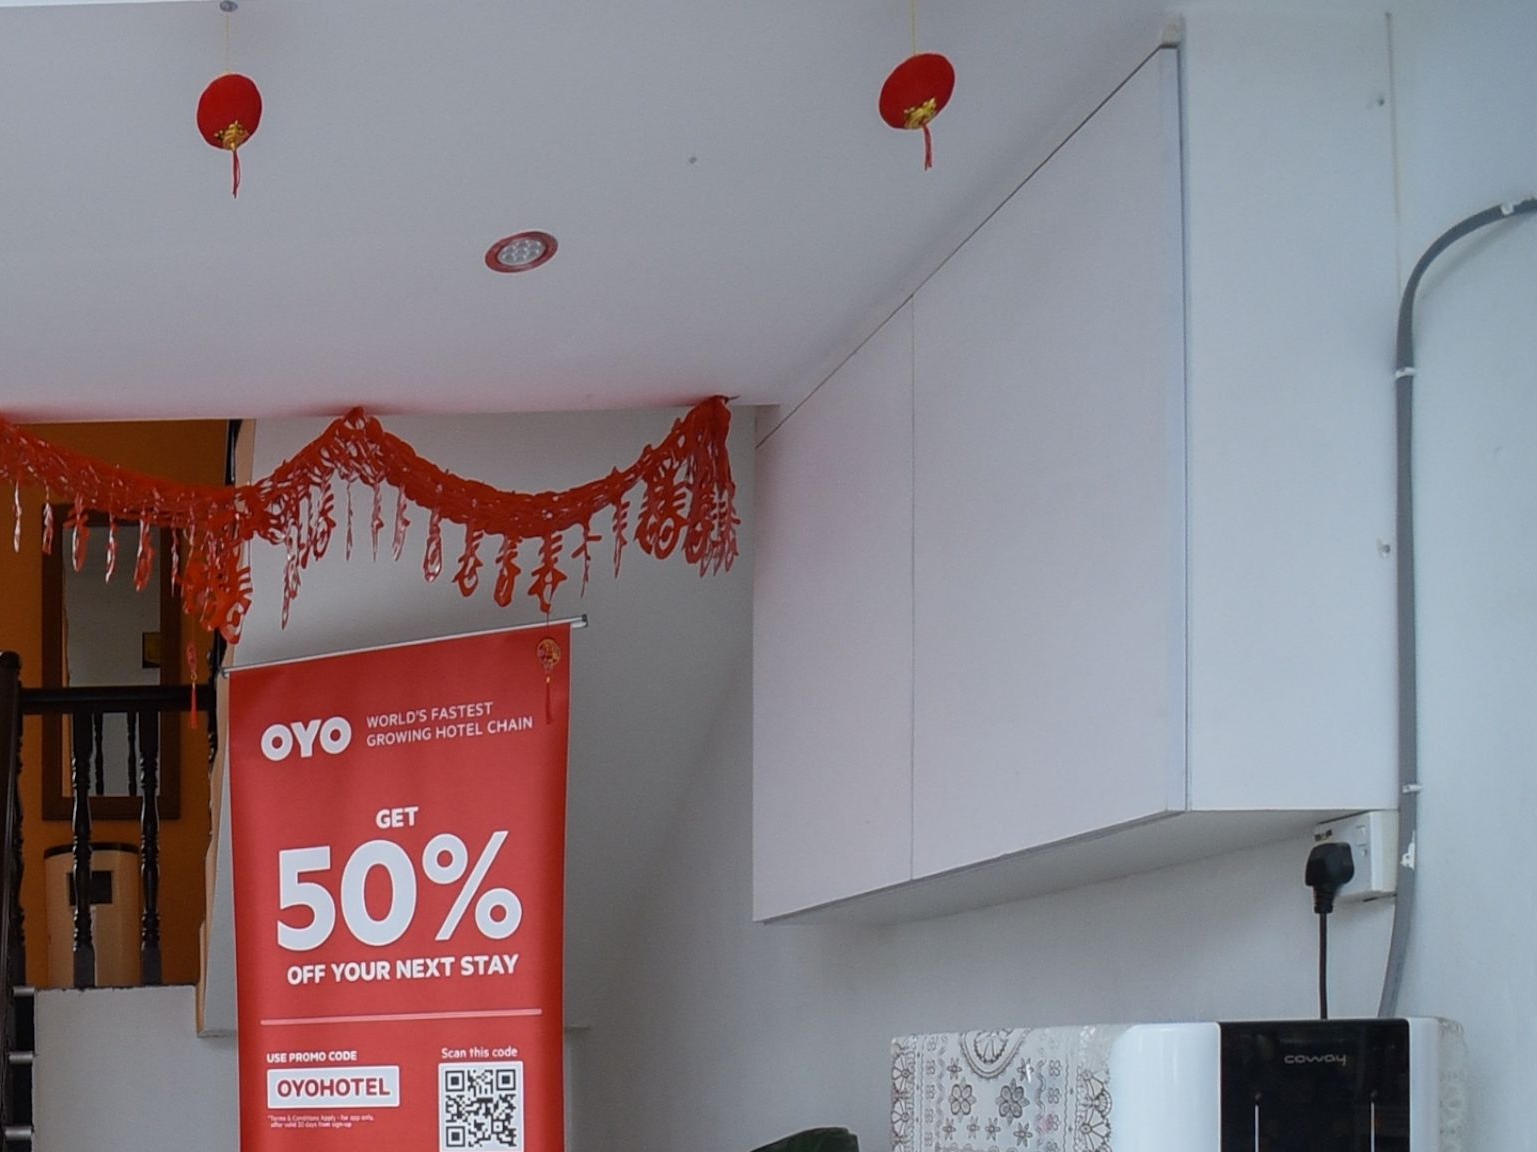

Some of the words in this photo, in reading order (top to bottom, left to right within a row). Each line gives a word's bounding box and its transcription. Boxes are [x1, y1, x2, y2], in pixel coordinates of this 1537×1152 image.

[366, 709, 427, 729] WORLD'S
[431, 702, 493, 721] FASTEST
[261, 716, 352, 761] OYO
[366, 728, 431, 747] GROWING
[435, 722, 483, 739] HOTEL
[487, 716, 533, 733] CHAIN
[375, 806, 419, 829] GET
[277, 830, 523, 951] 50%
[287, 964, 326, 985] OFF
[331, 960, 391, 982] YOUR
[396, 957, 455, 979] NEXT
[460, 954, 519, 976] STAY
[266, 1052, 287, 1063] USE
[288, 1051, 326, 1063] PROMO
[328, 1050, 358, 1062] CODE
[441, 1047, 467, 1059] Scan
[469, 1046, 489, 1058] this
[492, 1046, 518, 1058] code
[1283, 1053, 1347, 1066] coway
[277, 1078, 391, 1098] OYOHOTEL
